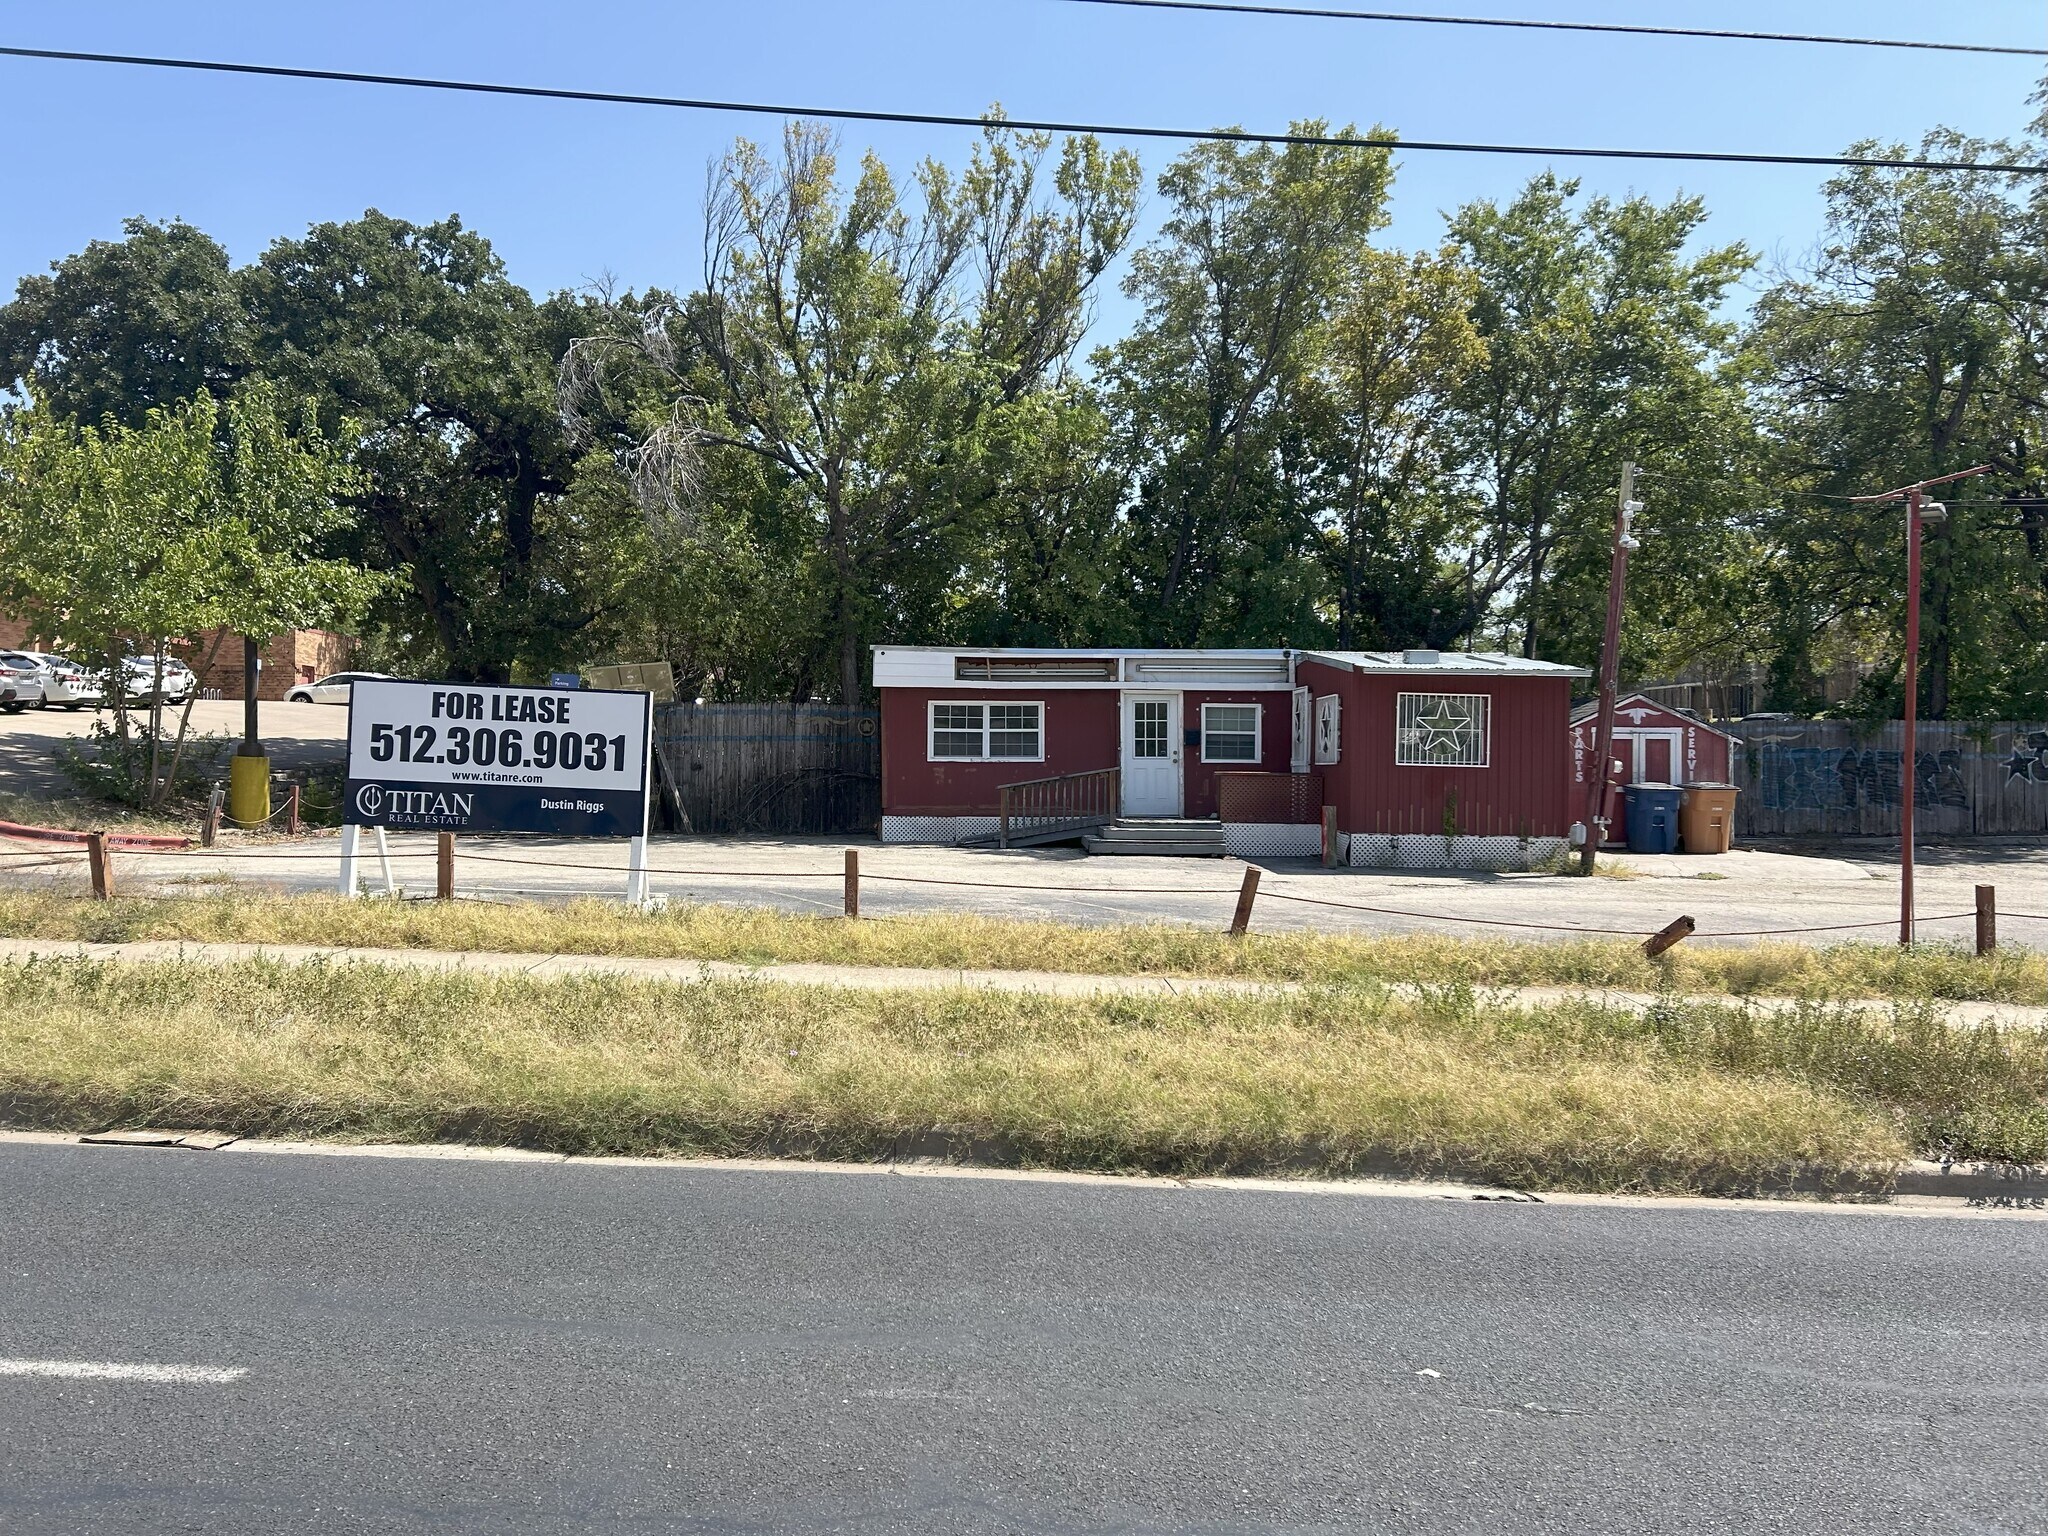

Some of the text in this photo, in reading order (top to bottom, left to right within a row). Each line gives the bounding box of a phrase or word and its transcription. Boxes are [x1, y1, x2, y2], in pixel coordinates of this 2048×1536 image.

[431, 691, 571, 724] FOR LEASE
[369, 723, 626, 772] 512.306.9031
[1574, 727, 1584, 782] PARTS
[451, 771, 543, 784] www.titanre.com
[385, 790, 475, 816] TITAN
[540, 798, 605, 814] Dustin Riggs
[388, 813, 468, 825] REAL ESTATE
[109, 837, 152, 847] AWAY ZONE
